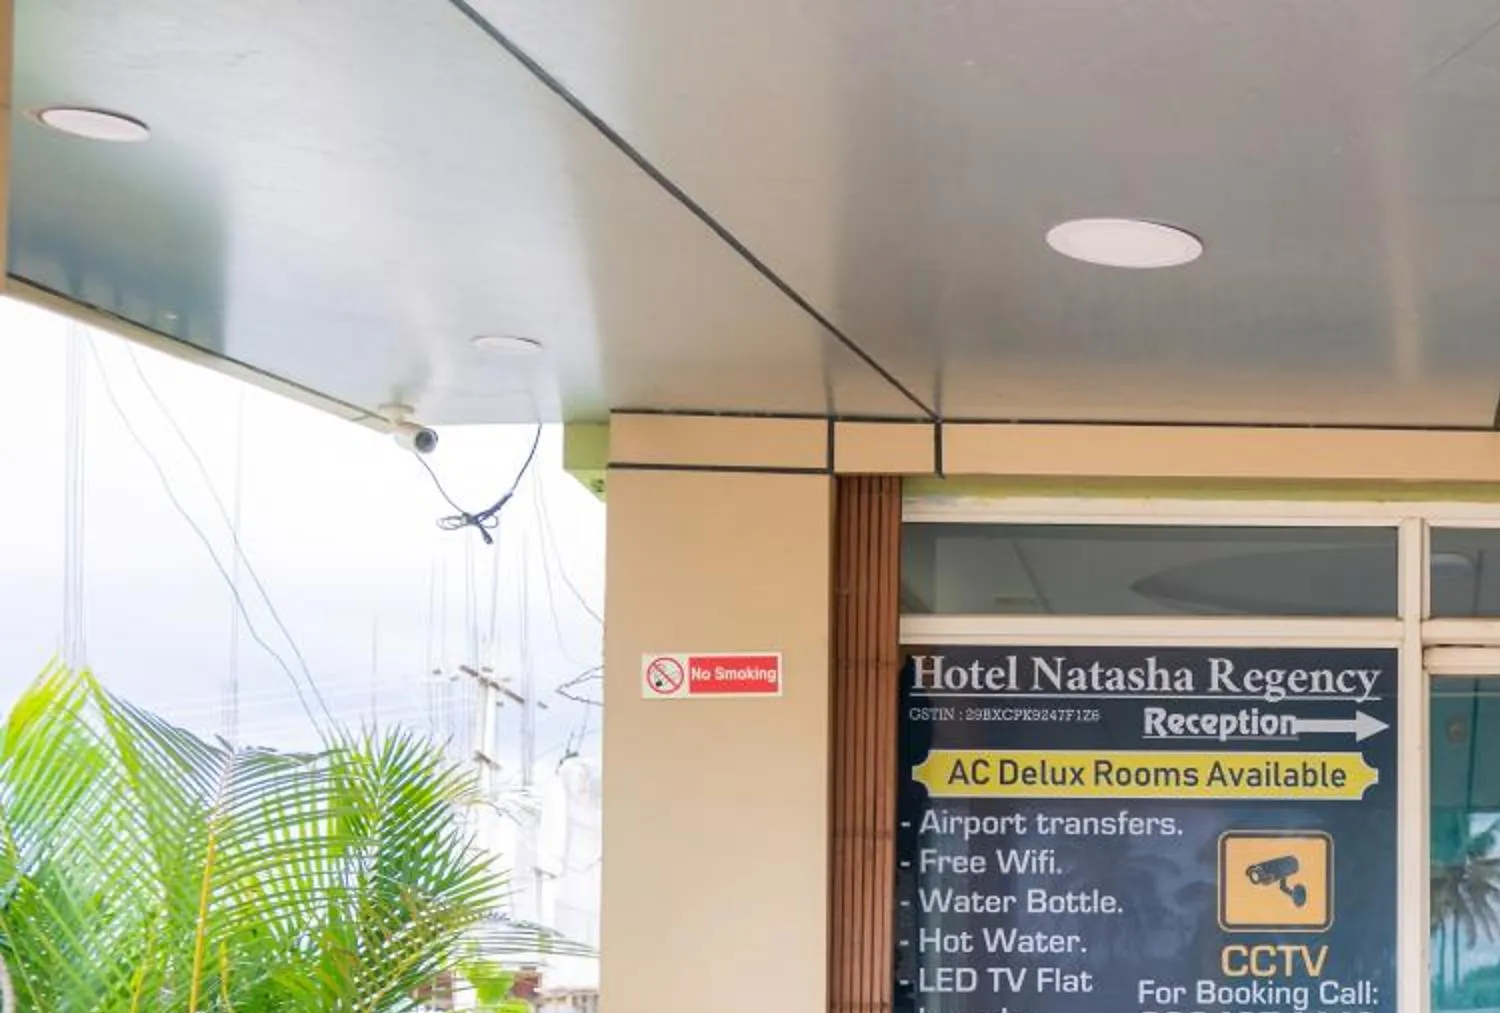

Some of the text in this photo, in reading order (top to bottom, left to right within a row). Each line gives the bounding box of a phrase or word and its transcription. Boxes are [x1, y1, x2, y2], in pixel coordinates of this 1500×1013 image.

[691, 666, 777, 683] No Smoking
[911, 655, 1382, 701] Hotel Natasha Regency
[1144, 706, 1299, 740] Reception
[948, 760, 1347, 787] AC Delux Rooms Available
[919, 811, 1184, 840] Airport transfers.
[919, 848, 1063, 875] Free Wifi.
[919, 889, 1124, 914] Water Bottle.
[919, 928, 1088, 954] Hot Water.
[1221, 944, 1328, 977] CCTV
[919, 968, 1093, 994] LED TV Flat
[1138, 981, 1379, 1011] For Booking Call:
